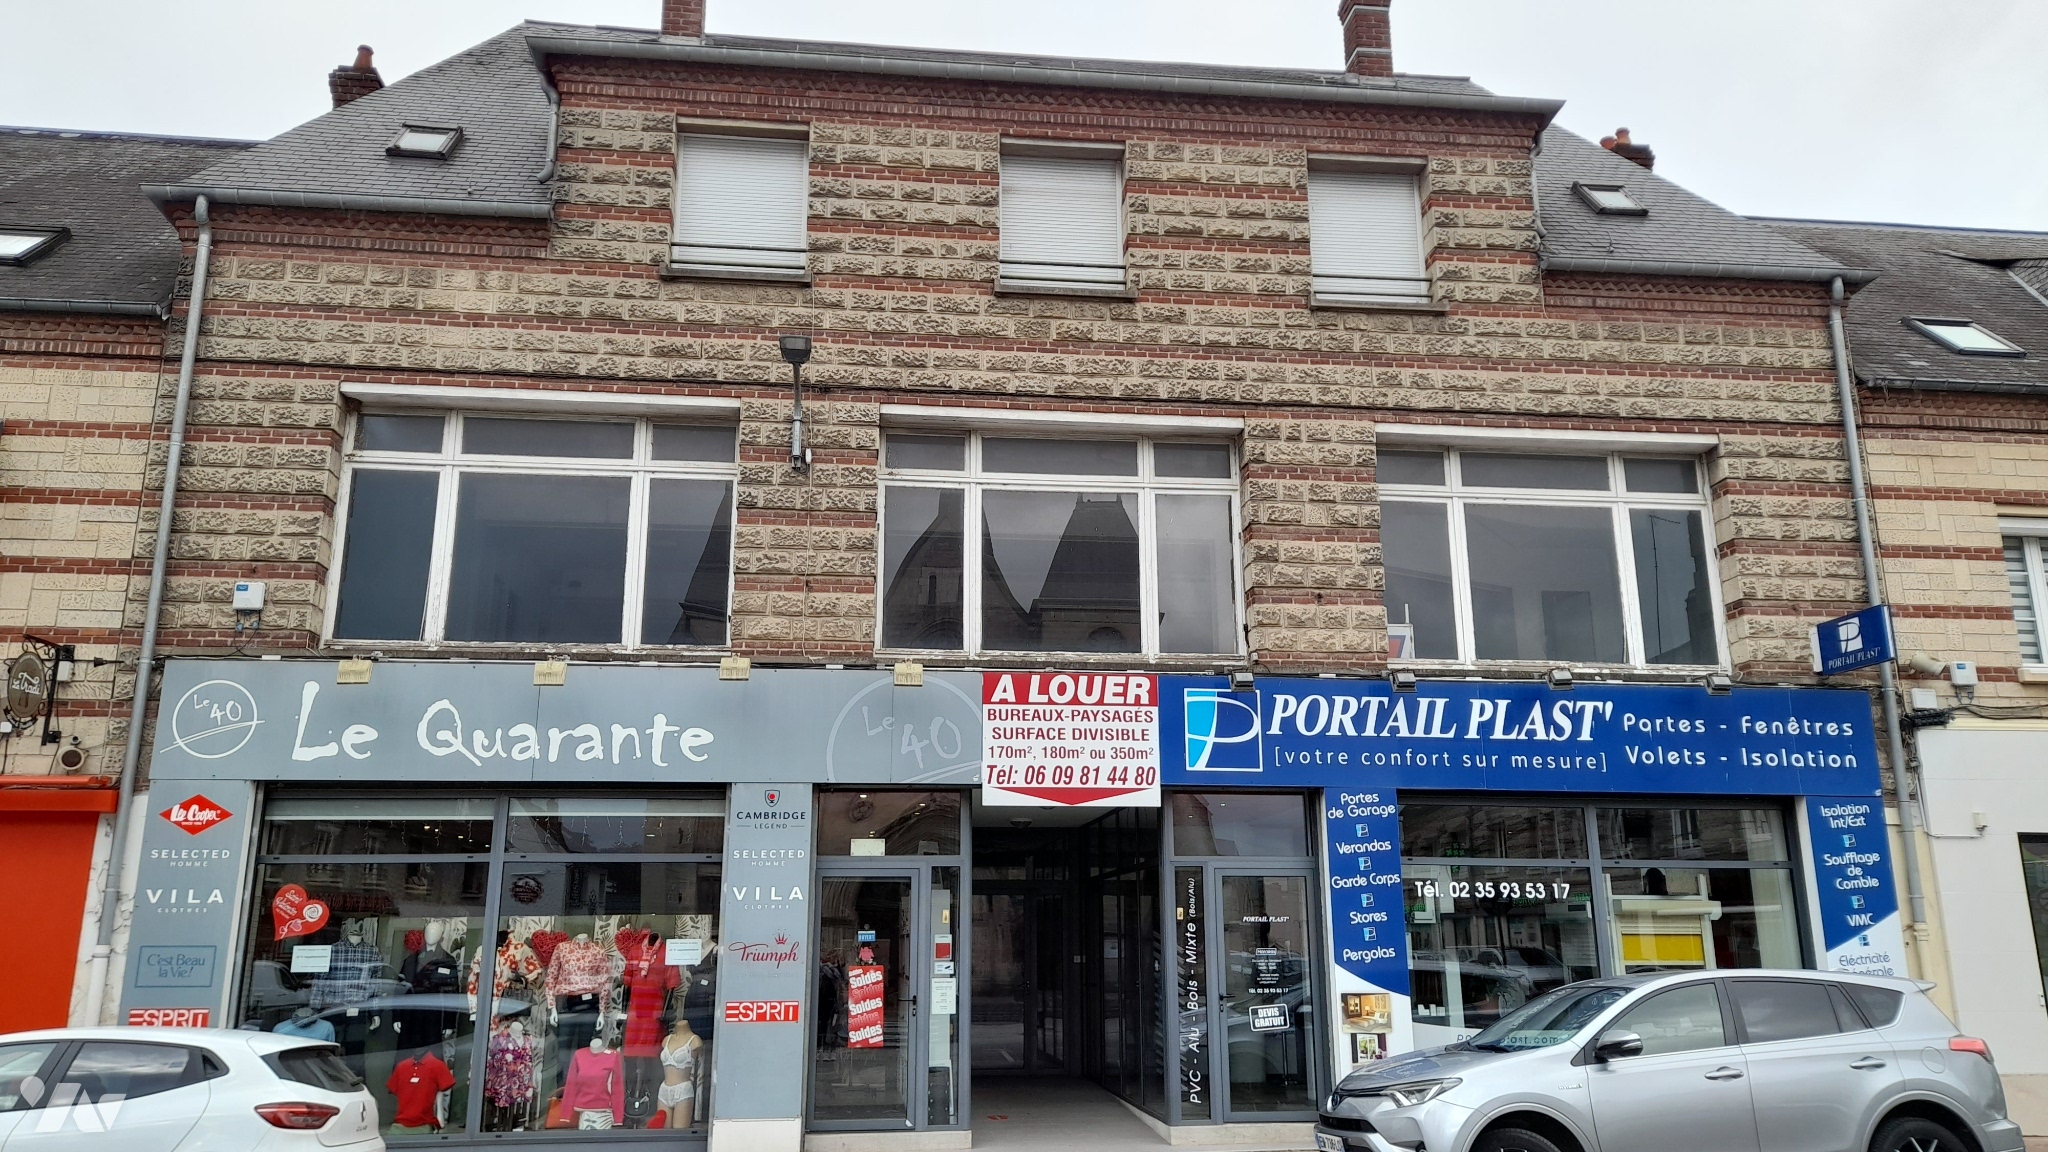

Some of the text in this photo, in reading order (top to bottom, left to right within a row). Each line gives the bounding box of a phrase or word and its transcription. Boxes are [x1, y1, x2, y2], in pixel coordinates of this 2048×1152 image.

[1828, 654, 1856, 669] PORTAIL
[990, 674, 1151, 704] A LOUER
[194, 694, 242, 725] Le 40
[988, 707, 1154, 723] BUREAUX-PAYSAGÉS
[1266, 694, 1457, 738] PORTAIL
[292, 680, 714, 766] Le Quarante
[1623, 713, 1706, 733] Portes
[1742, 716, 1854, 736] Fenêtres
[862, 706, 962, 770] Le 40
[992, 727, 1150, 742] SURFACE DIVISIBLE
[1090, 749, 1106, 760] ou
[1361, 748, 1451, 767] confort
[1462, 754, 1498, 768] sur
[1624, 746, 1706, 765] Volets
[1742, 748, 1858, 768] Isolation
[987, 764, 1156, 786] Tél: 06 09 81 44 80
[1340, 792, 1380, 804] Portes
[736, 812, 806, 820] CAMBRIDGE
[1328, 804, 1396, 819] de Garage
[1821, 804, 1870, 816] Isolation
[1830, 816, 1866, 828] Int/Ext
[150, 850, 230, 859] SELECTED
[733, 850, 805, 859] SELECTED
[1336, 839, 1392, 855] Verandas
[1824, 852, 1880, 866] Soufflage
[1848, 866, 1864, 876] de
[1332, 872, 1400, 888] Garde Corps
[1836, 876, 1880, 890] Comble
[146, 888, 224, 904] VILA
[732, 886, 804, 900] VILA
[1414, 880, 1444, 898] Tél.
[1450, 882, 1470, 898] 02
[1474, 882, 1496, 898] 35
[1500, 882, 1520, 898] 93
[1525, 883, 1546, 898] 53
[1552, 884, 1570, 899] 17
[1350, 911, 1388, 924] Stores
[1847, 913, 1876, 926] VMC
[1185, 922, 1197, 964] Mixte
[147, 954, 206, 966] C'est Beau
[728, 941, 800, 969] Triumph
[1343, 946, 1396, 963] Pergolas
[158, 966, 194, 978] la Vie!
[850, 970, 882, 989] Soldes
[726, 1002, 799, 1022] ESPRIT
[849, 998, 882, 1016] Soldes
[1258, 1008, 1280, 1018] DEVIS
[128, 1009, 210, 1027] ESPRIT
[1254, 1016, 1284, 1028] GRATUIT
[849, 1024, 882, 1043] Soldes
[1188, 1028, 1200, 1053] Alu
[1189, 1070, 1202, 1104] PVC
